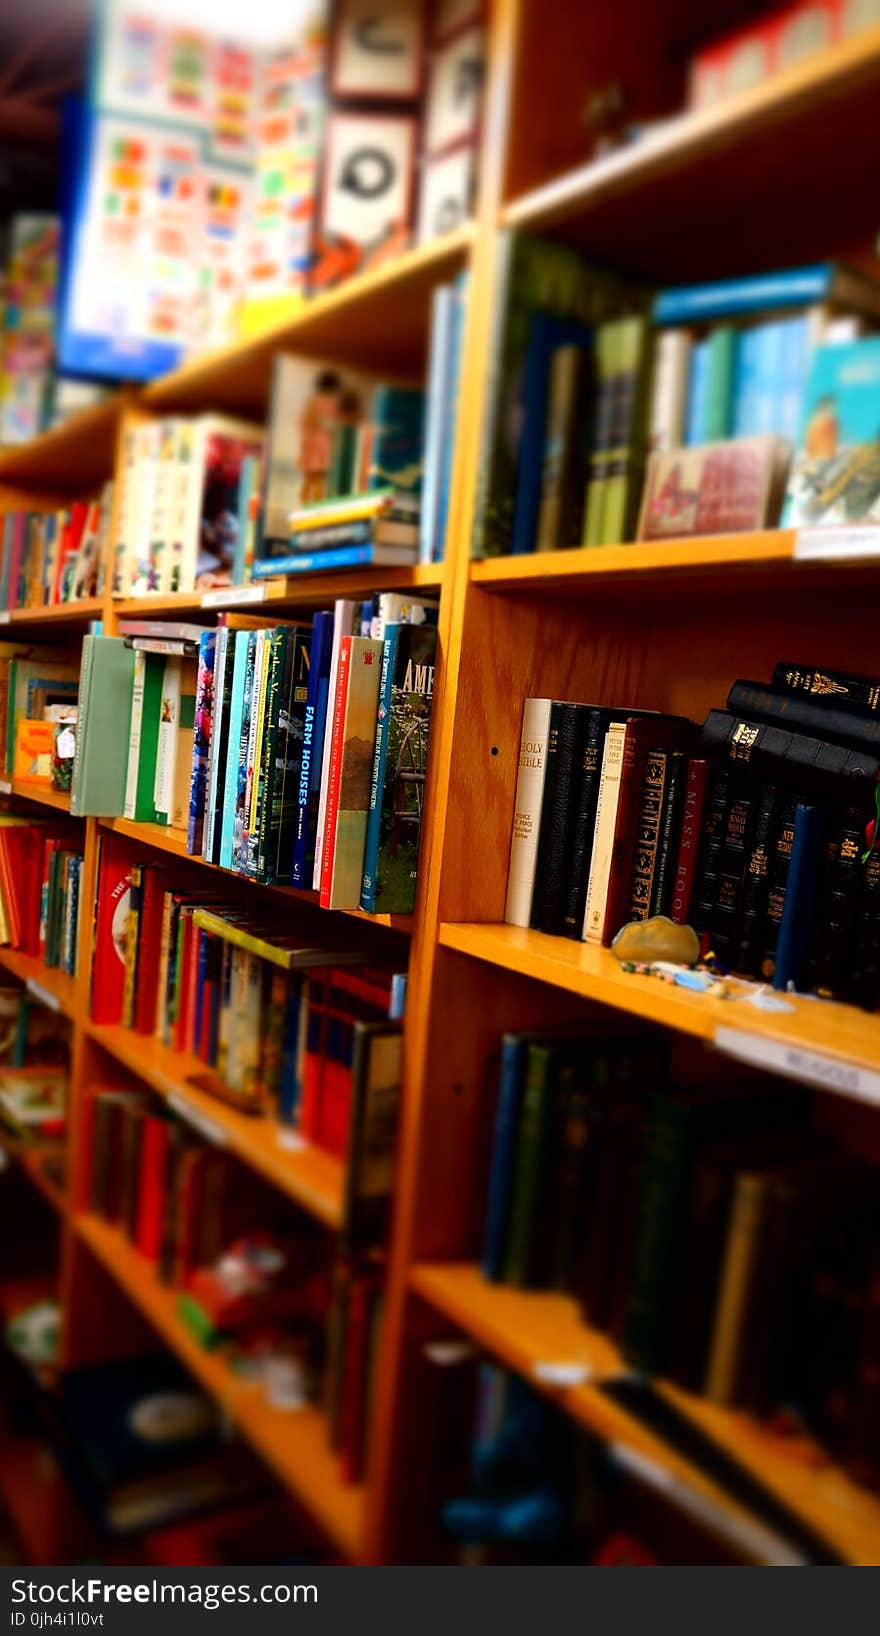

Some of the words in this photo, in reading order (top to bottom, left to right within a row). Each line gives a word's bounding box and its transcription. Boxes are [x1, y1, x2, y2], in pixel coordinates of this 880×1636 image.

[271, 635, 283, 679] Martha's
[383, 640, 391, 658] MARY
[302, 705, 315, 745] FARM
[333, 711, 341, 743] PRINCE
[375, 723, 384, 753] AMERICAN
[332, 748, 338, 760] OF
[298, 748, 311, 805] HOUSES
[329, 765, 337, 795] WALES
[323, 798, 334, 873] WATERCOLOURS
[664, 804, 673, 837] MEANING
[682, 791, 697, 848] MASS
[659, 853, 667, 881] PRAYER
